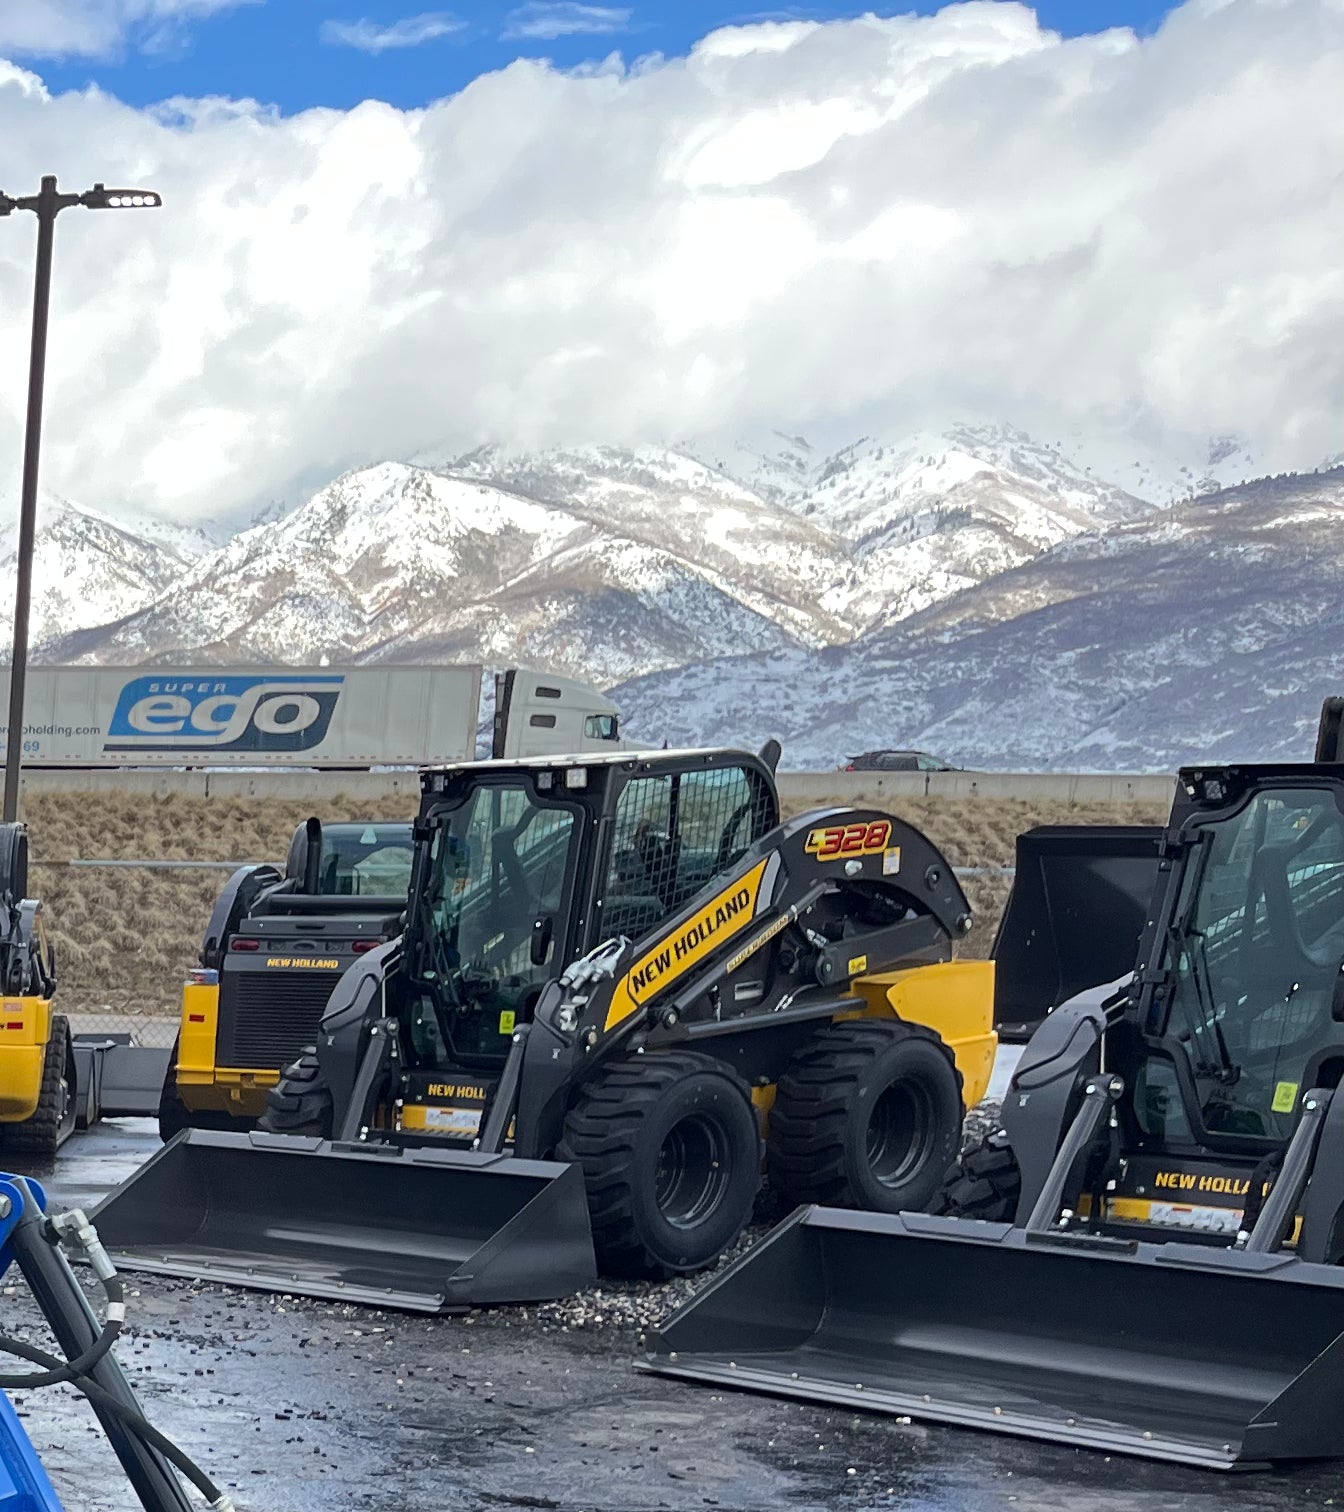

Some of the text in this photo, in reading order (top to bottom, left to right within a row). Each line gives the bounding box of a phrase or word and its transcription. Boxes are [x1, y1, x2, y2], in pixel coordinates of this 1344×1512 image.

[149, 683, 227, 693] SUPER
[127, 693, 321, 743] ego
[632, 888, 750, 994] NEW HOLLAND
[267, 958, 339, 969] NEW HOLLAND
[428, 1083, 454, 1096] NEW
[1155, 1172, 1197, 1189] NEW
